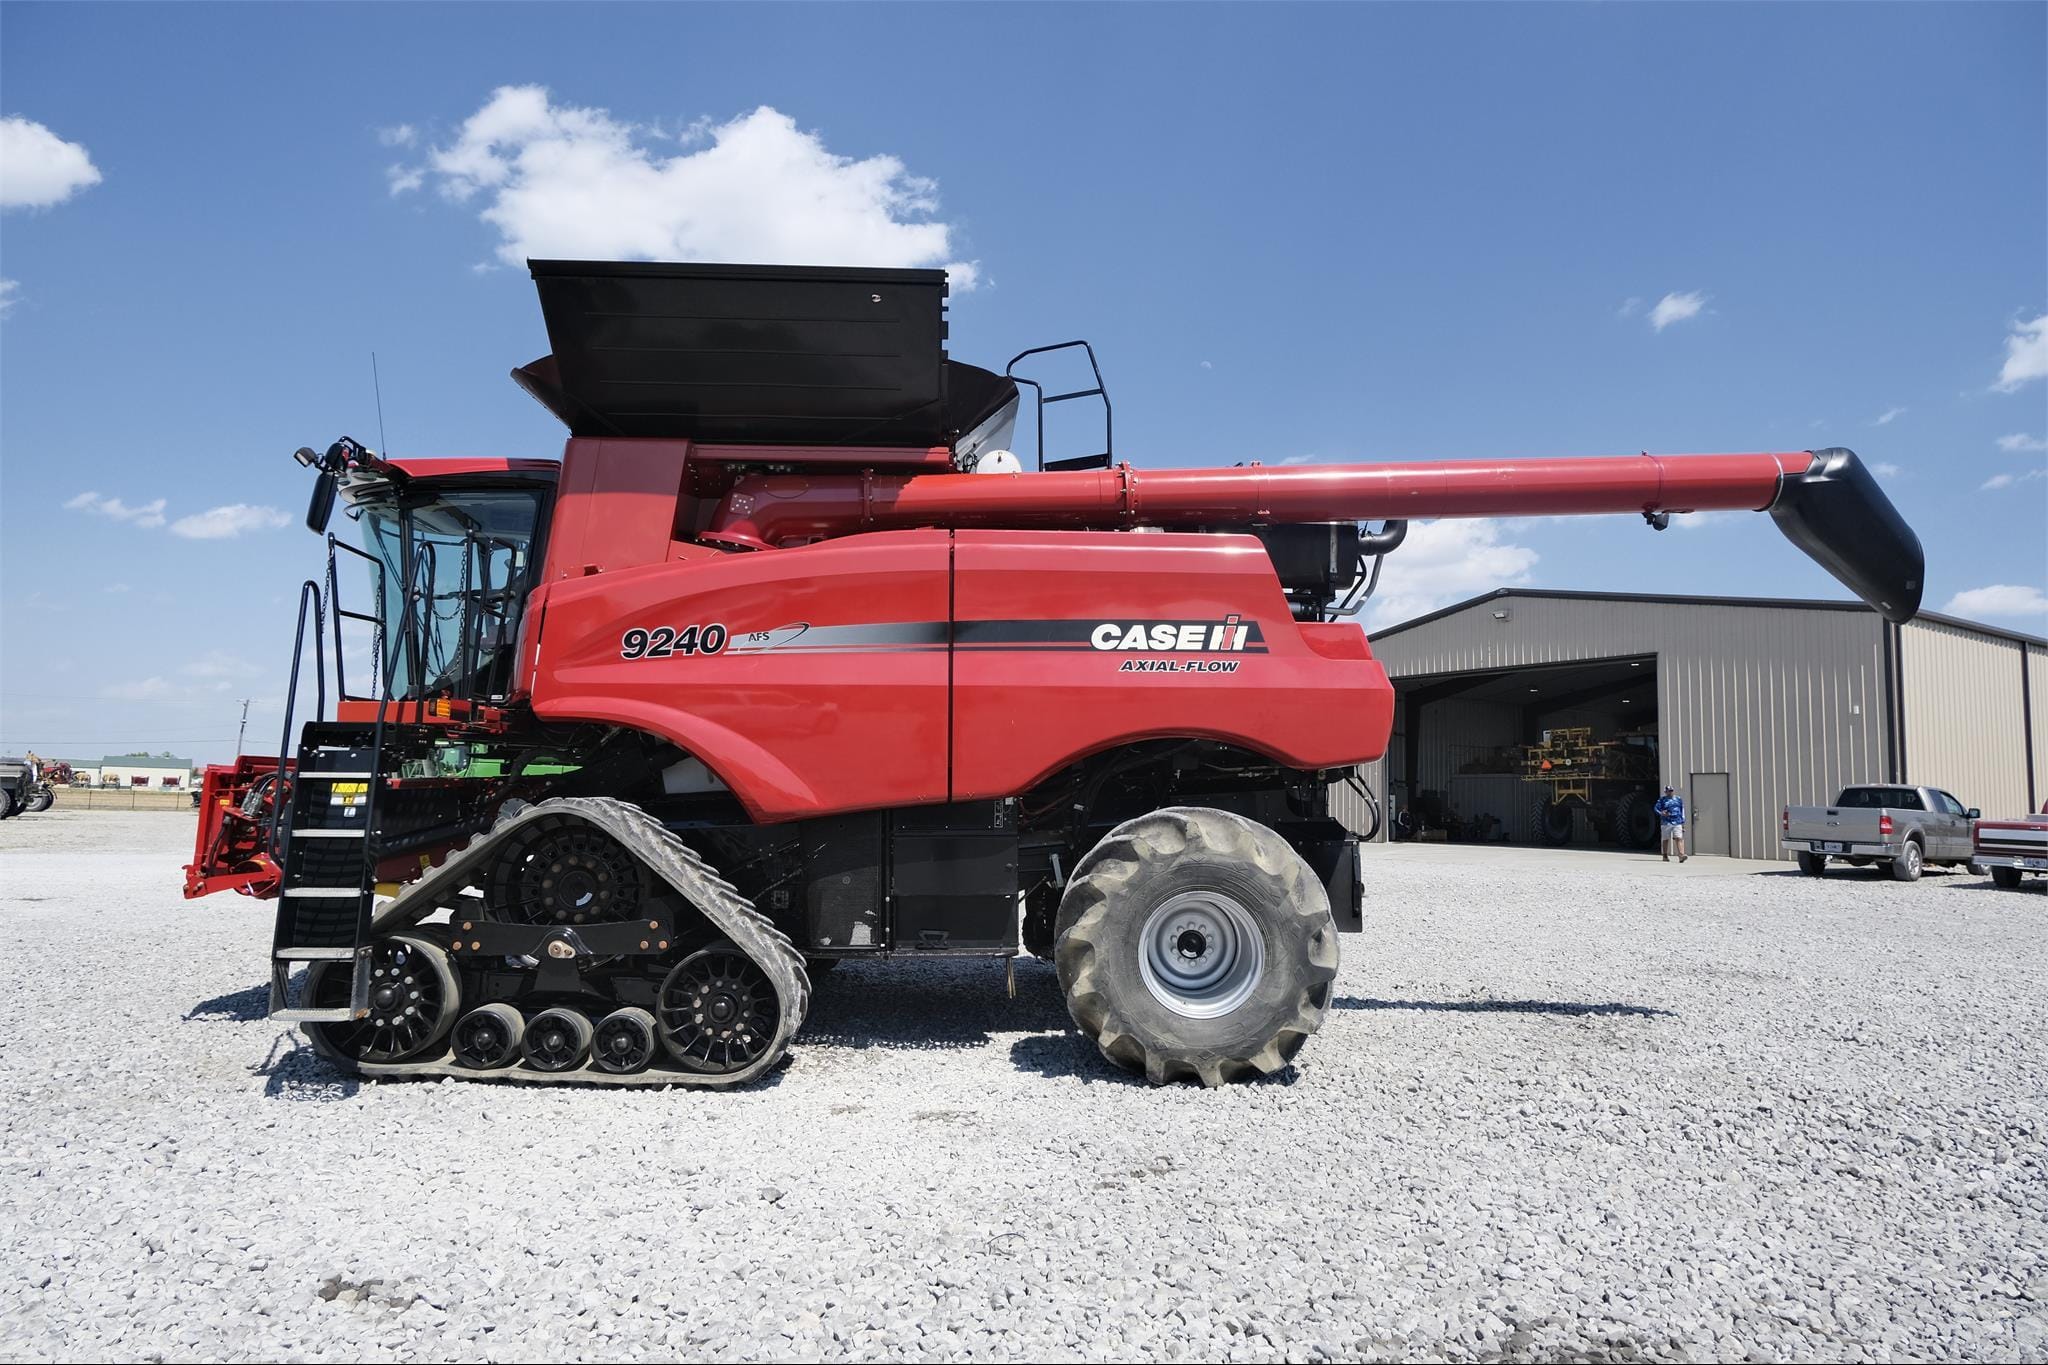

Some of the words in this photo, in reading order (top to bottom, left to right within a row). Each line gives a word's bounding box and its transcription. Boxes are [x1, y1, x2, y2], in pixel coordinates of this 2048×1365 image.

[621, 623, 727, 660] 9240
[748, 631, 770, 642] AFS
[1091, 623, 1207, 651] CASE
[1119, 660, 1239, 673] AXIAL-FLOW
